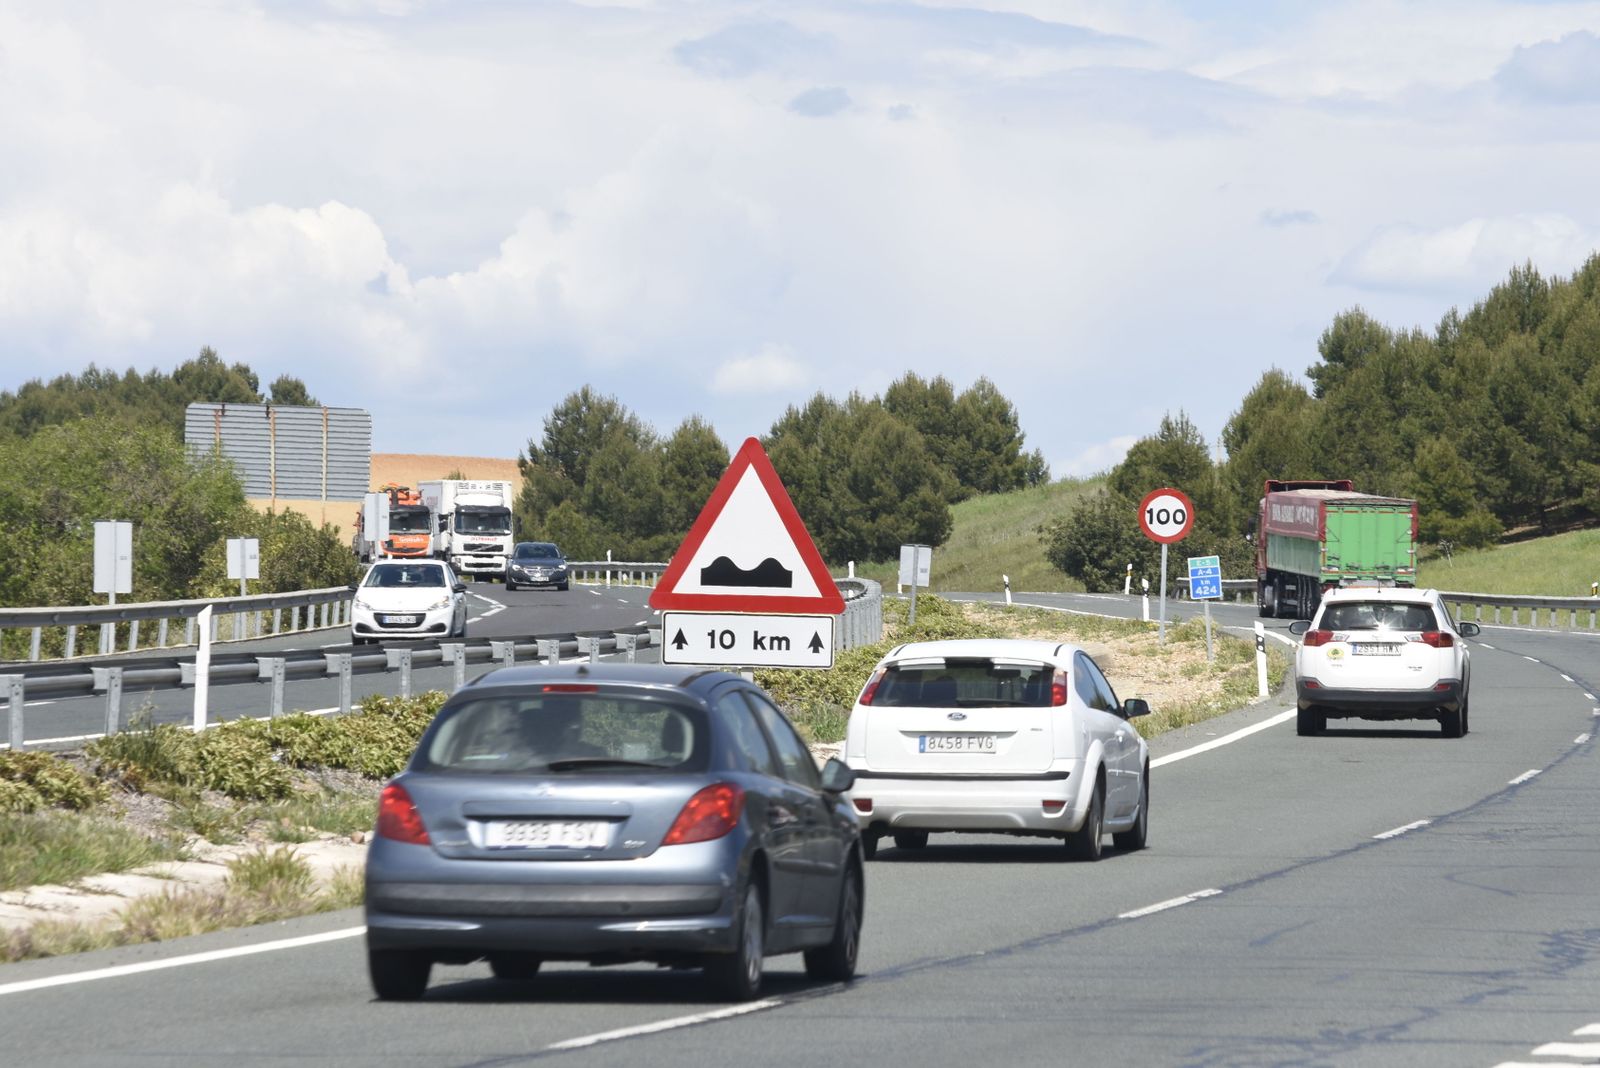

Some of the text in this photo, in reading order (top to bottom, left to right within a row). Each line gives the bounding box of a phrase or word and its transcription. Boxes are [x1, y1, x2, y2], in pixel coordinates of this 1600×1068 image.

[1146, 508, 1186, 525] 100
[1195, 585, 1217, 595] 424
[707, 629, 791, 651] 10 km
[928, 736, 993, 750] 8458 FVG
